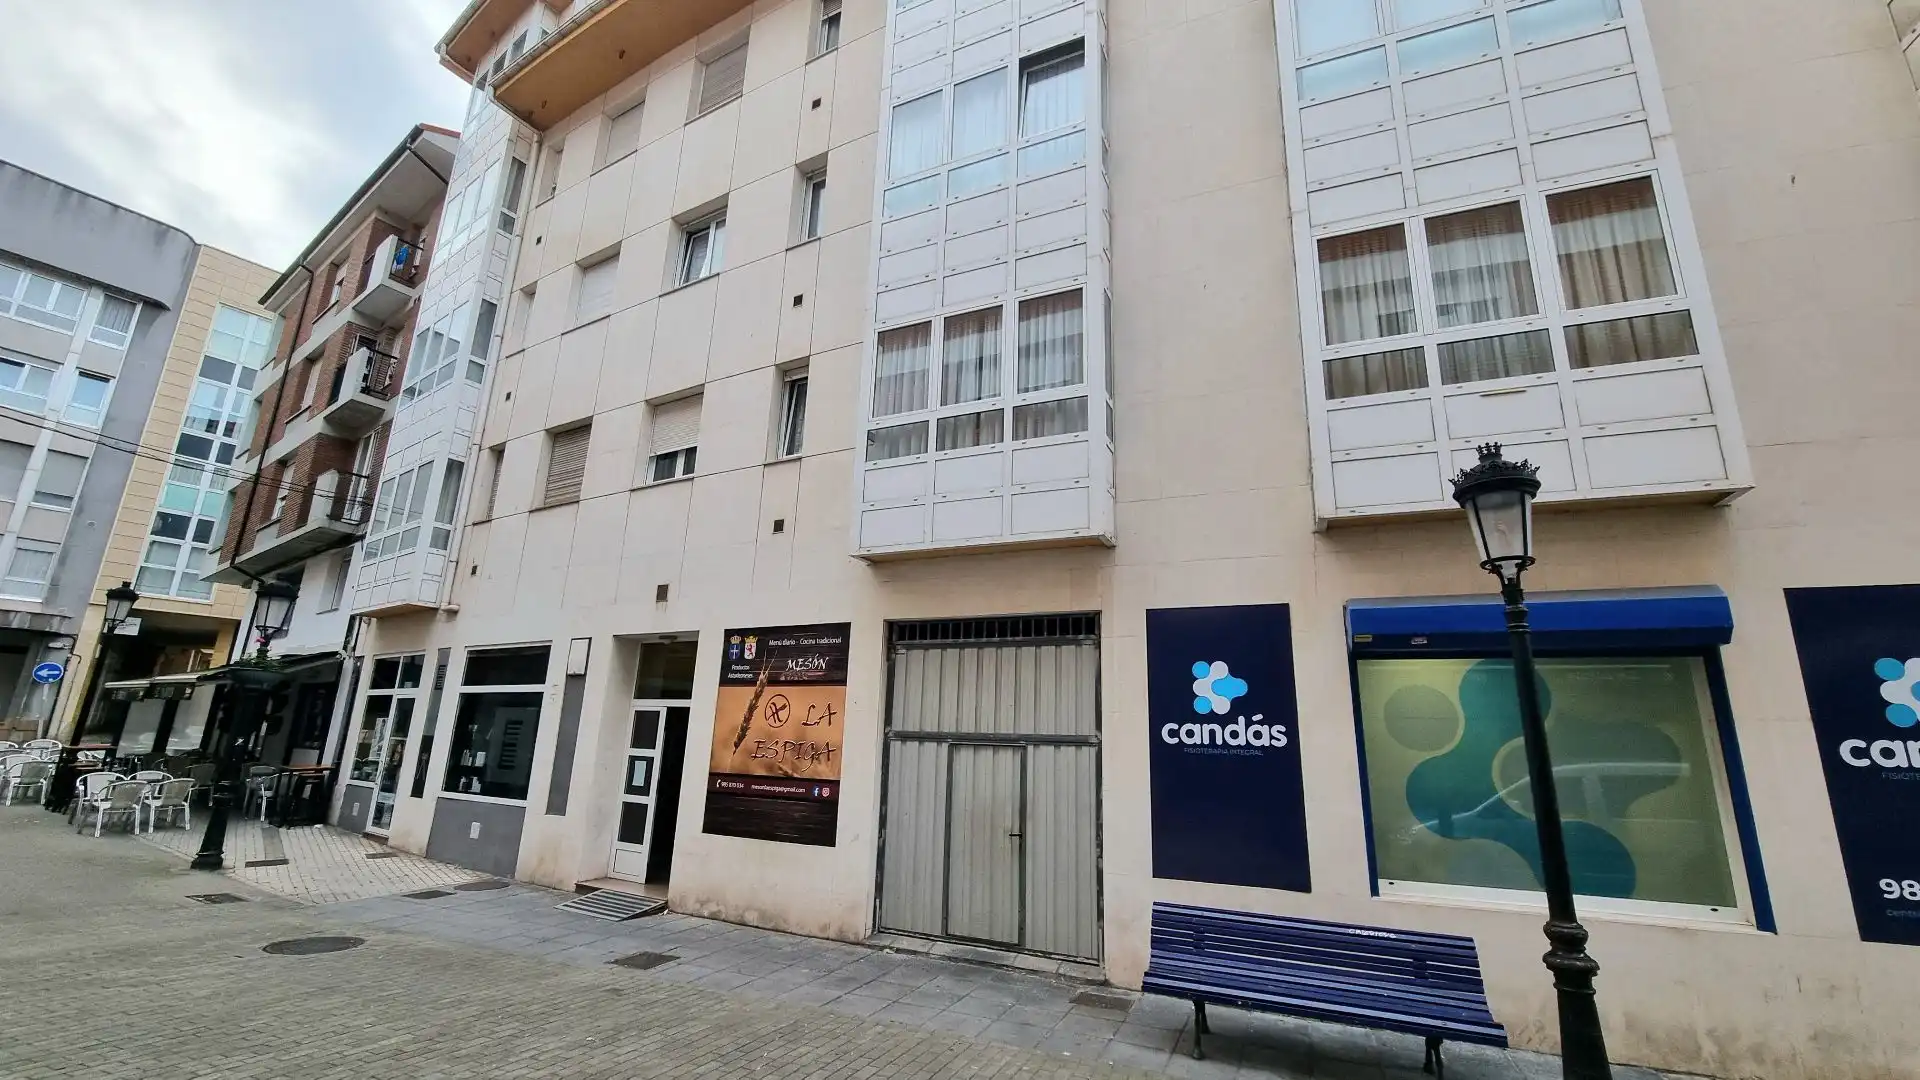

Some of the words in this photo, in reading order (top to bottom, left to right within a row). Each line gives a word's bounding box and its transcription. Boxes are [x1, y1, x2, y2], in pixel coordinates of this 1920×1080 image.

[786, 653, 829, 671] MESÓN
[801, 702, 838, 727] LA
[1161, 713, 1288, 748] candás
[751, 739, 837, 773] ESPIGA
[1183, 747, 1228, 756] FISIOTERAPIA
[1229, 748, 1264, 757] INTEGRAL
[1879, 878, 1920, 901] 98
